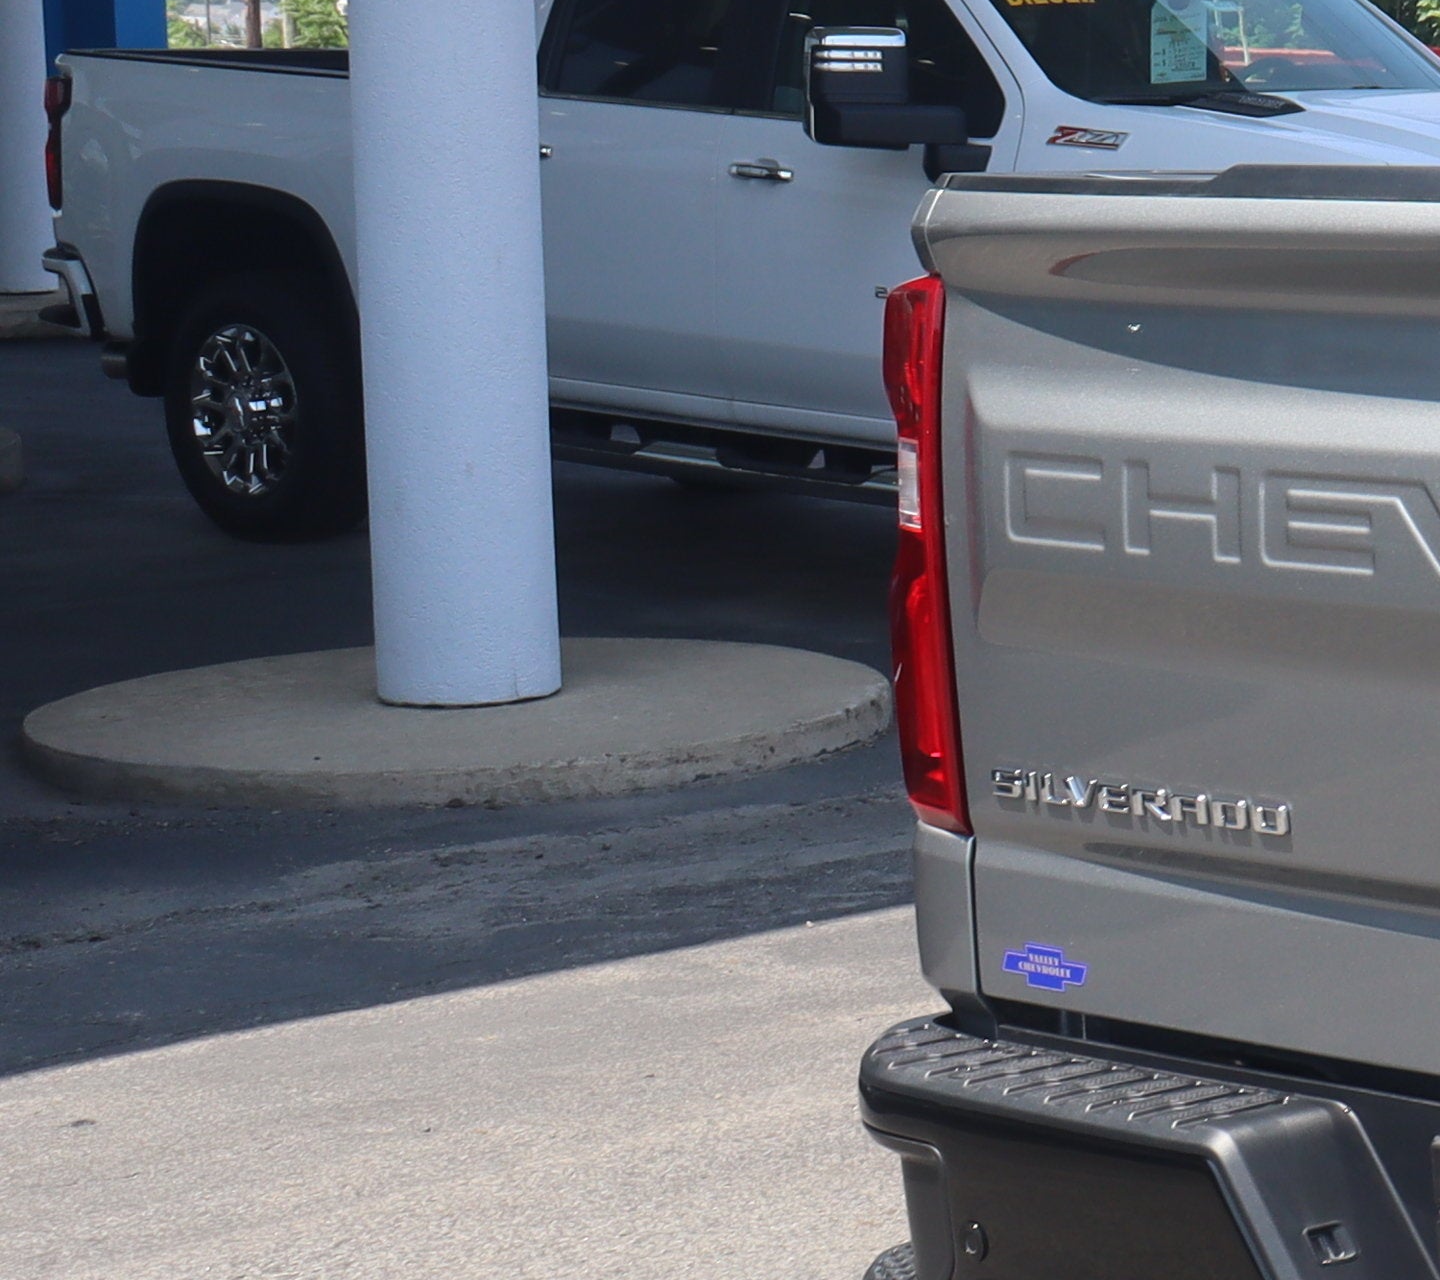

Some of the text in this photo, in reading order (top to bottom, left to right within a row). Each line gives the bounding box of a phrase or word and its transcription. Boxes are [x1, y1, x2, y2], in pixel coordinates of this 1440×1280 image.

[991, 768, 1292, 836] SILVERADO
[1028, 953, 1060, 966] VALLEY
[1018, 960, 1071, 978] CHEVROLET
